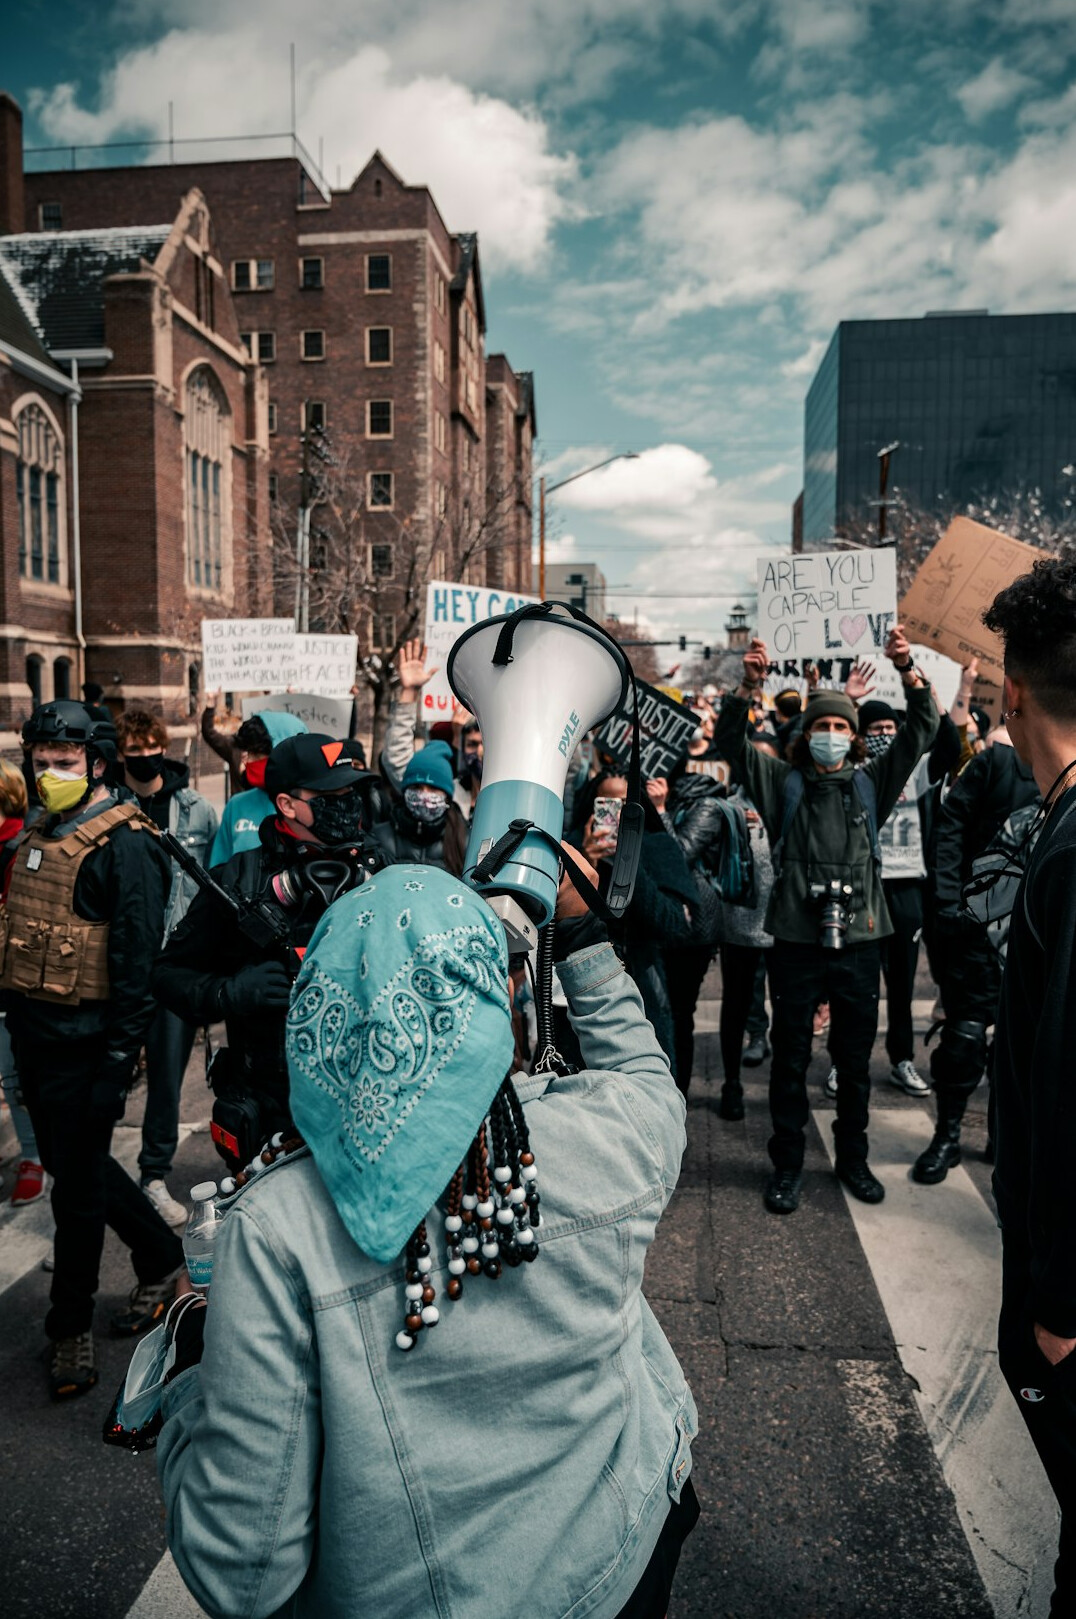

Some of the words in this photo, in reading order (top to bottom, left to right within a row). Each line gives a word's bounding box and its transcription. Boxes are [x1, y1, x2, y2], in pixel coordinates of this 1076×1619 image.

[763, 558, 816, 592] ARE
[826, 554, 874, 586] YOU
[434, 589, 480, 622] HEY
[768, 586, 871, 620] CAPABLE
[299, 639, 351, 656] JUSTICE
[774, 620, 809, 653] OF
[558, 710, 580, 758] PYLE
[598, 715, 629, 748] NO
